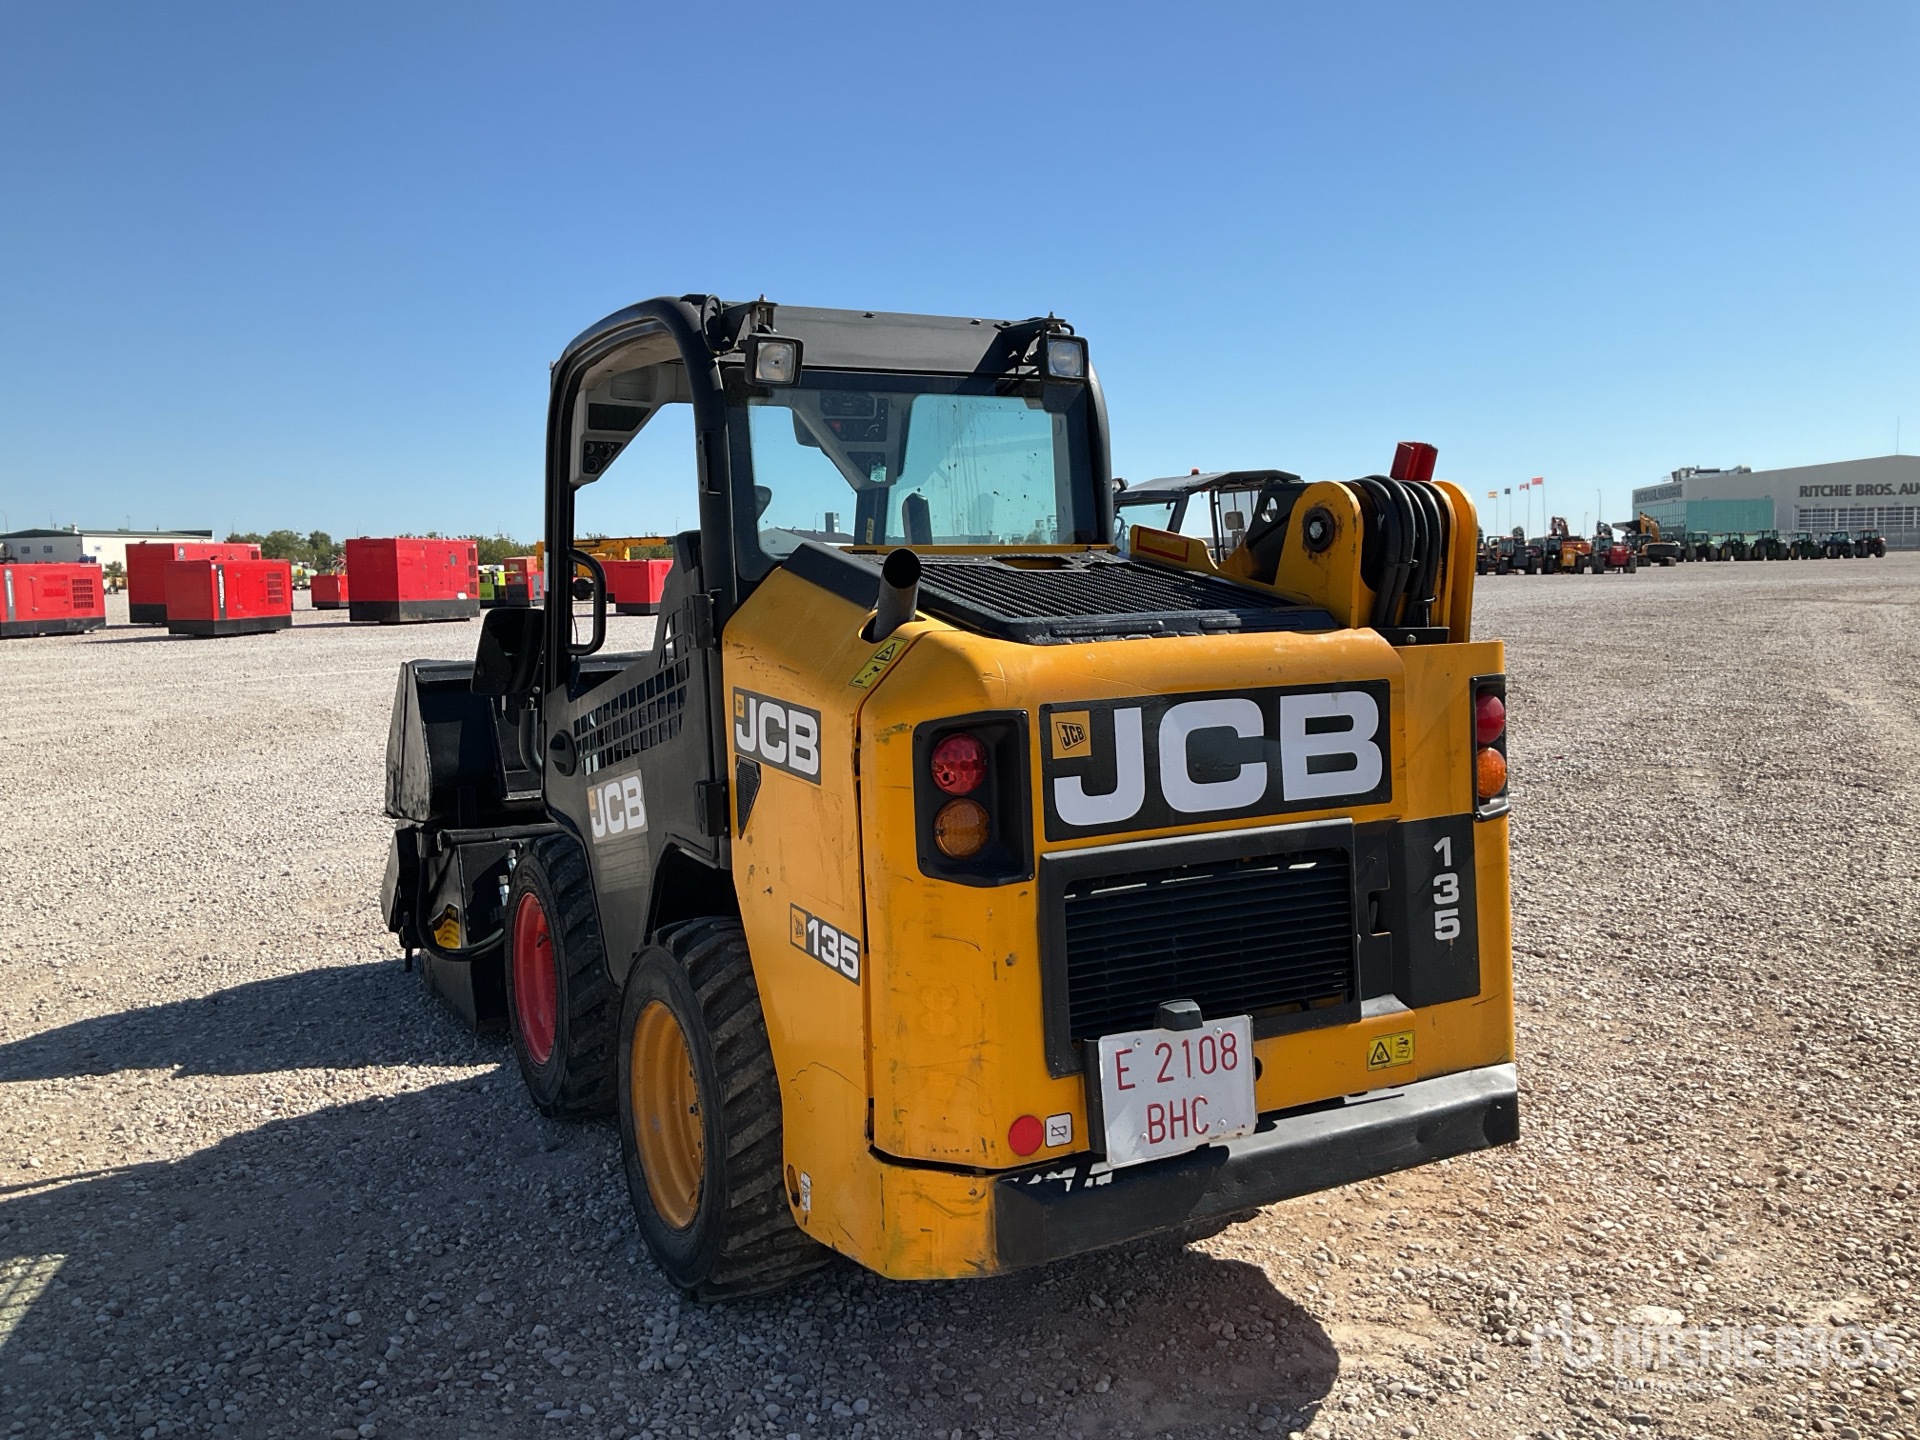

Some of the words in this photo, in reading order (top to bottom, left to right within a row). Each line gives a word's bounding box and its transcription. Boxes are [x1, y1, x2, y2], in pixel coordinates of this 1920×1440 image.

[1799, 484, 1853, 498] RITCHIE
[1855, 483, 1896, 496] BROS.
[1898, 482, 1920, 495] AU
[735, 697, 819, 775] JCB
[1053, 690, 1383, 826] JCB
[1061, 724, 1085, 747] JCB
[592, 776, 646, 838] JCB
[1433, 836, 1460, 941] 135
[807, 918, 859, 979] 135
[1115, 1048, 1136, 1091] E
[1154, 1031, 1238, 1083] 2108
[1147, 1095, 1209, 1144] BHC
